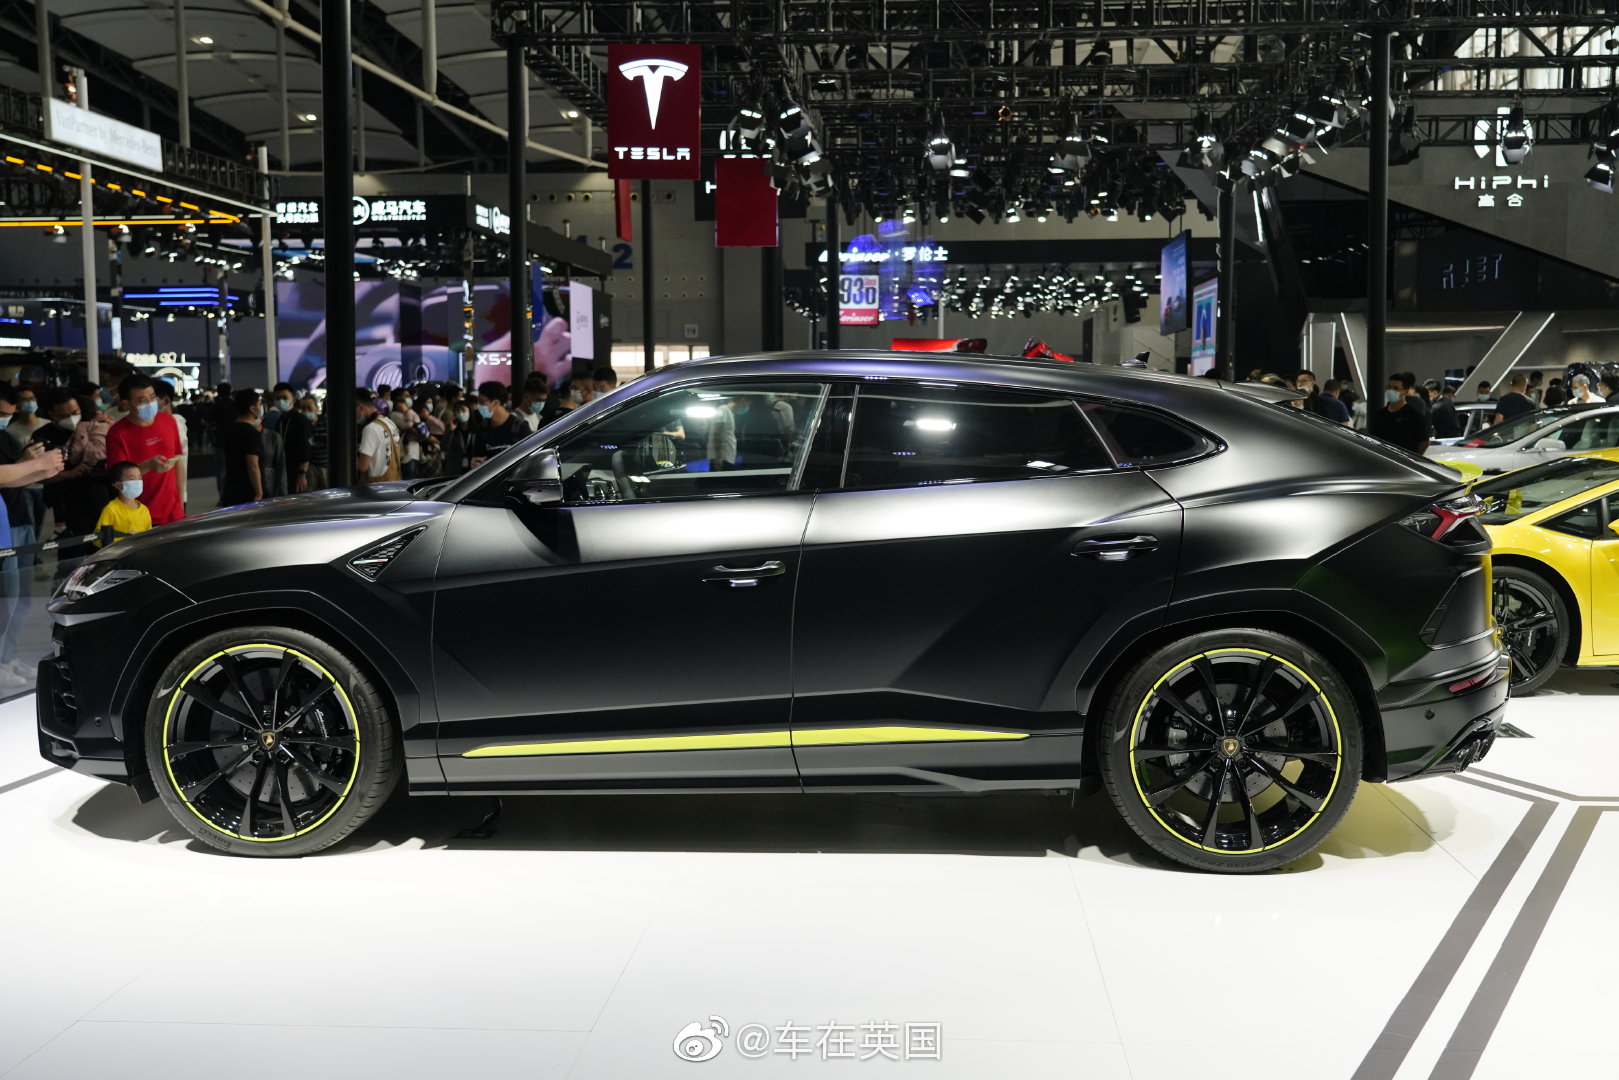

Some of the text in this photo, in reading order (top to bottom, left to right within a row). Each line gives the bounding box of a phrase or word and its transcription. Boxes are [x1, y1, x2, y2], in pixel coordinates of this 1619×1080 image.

[614, 147, 691, 160] TESLA
[1454, 175, 1549, 190] HiPhi
[371, 200, 426, 215] 威马汽车
